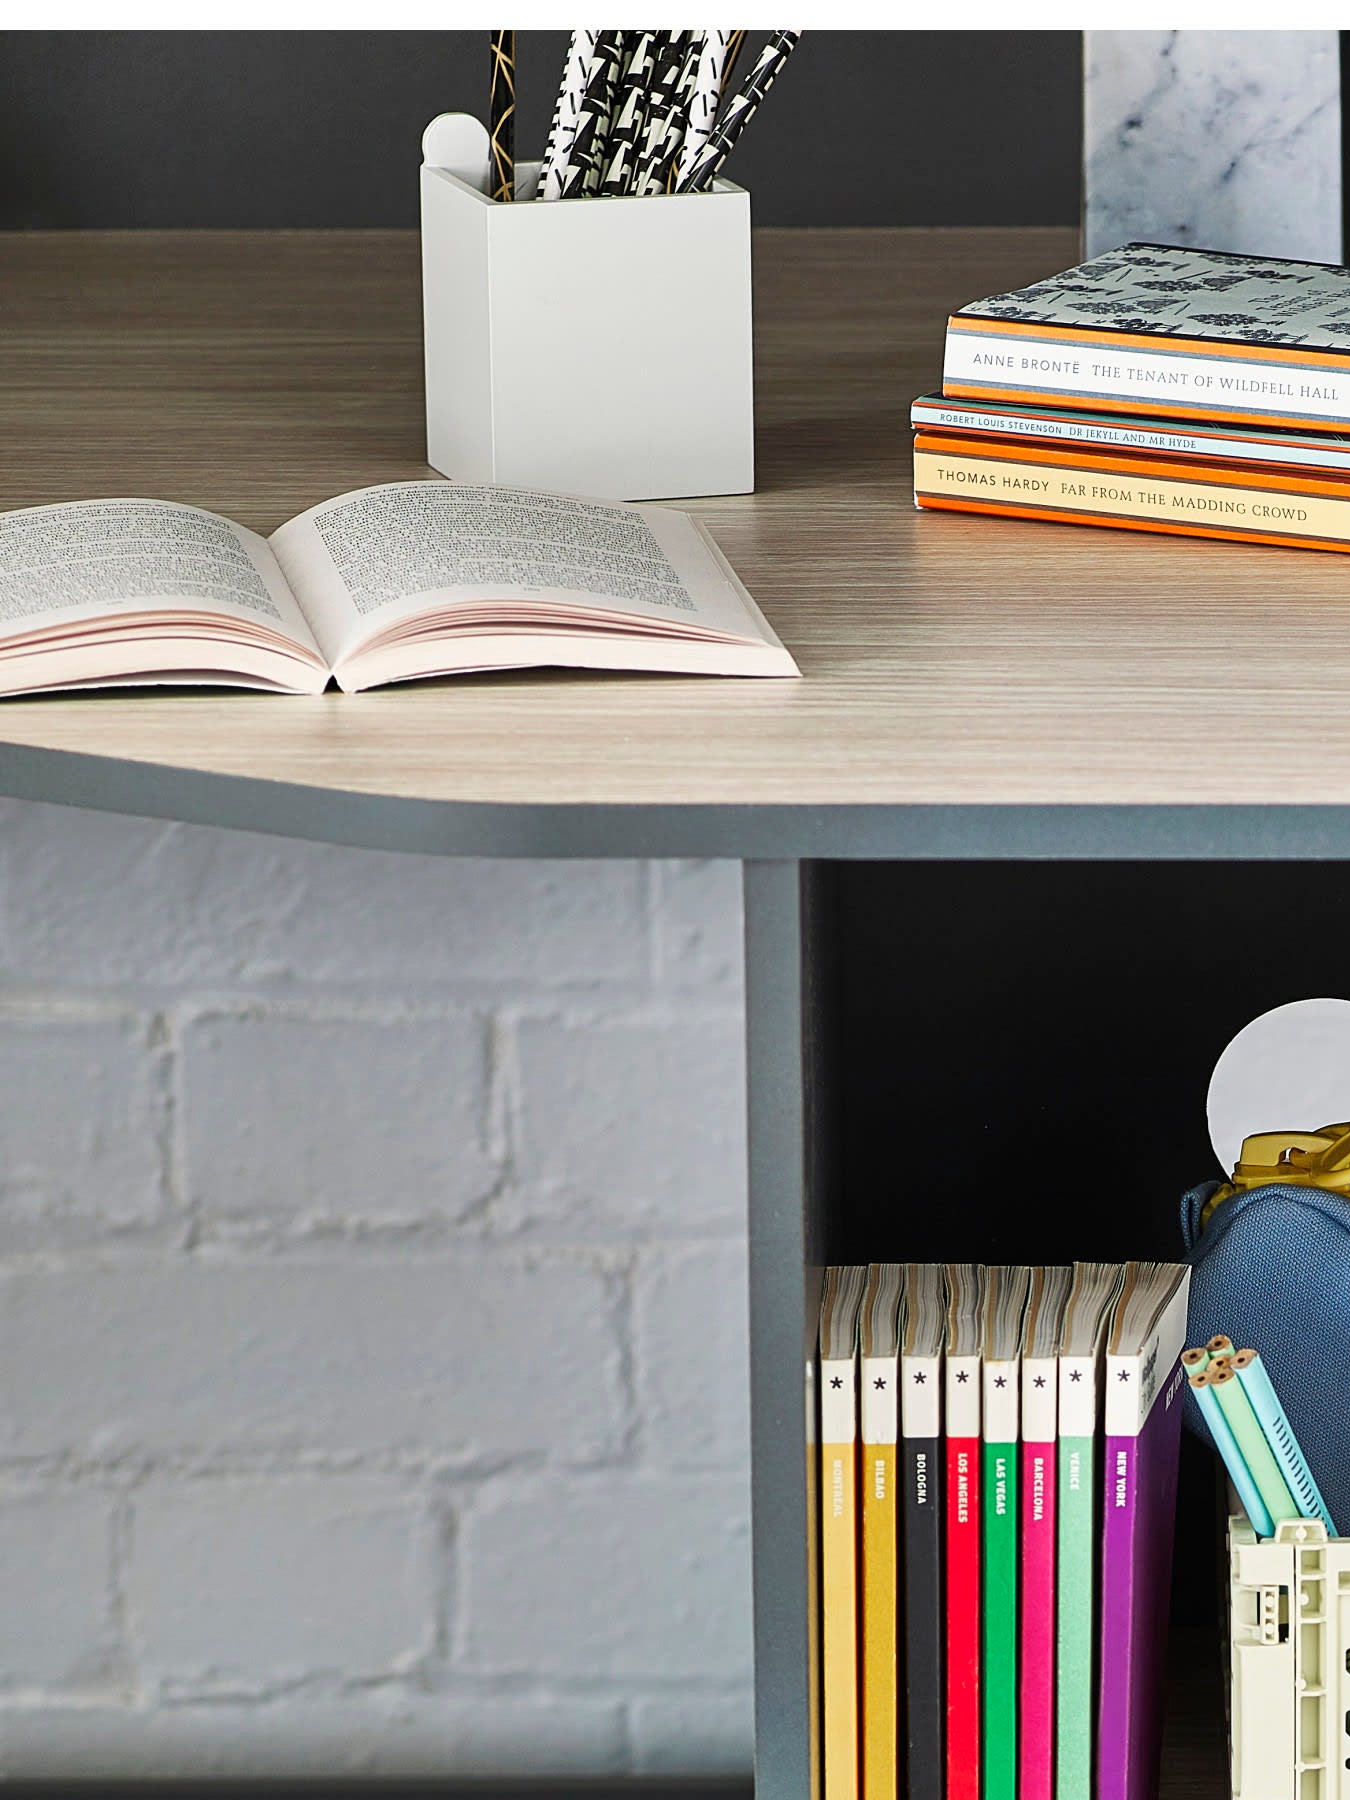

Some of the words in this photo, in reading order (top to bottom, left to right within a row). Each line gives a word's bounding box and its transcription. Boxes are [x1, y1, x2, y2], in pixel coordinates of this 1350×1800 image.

[973, 353, 1015, 368] ANNE
[1021, 358, 1080, 374] BRONTË
[1092, 364, 1121, 379] THE
[1127, 368, 1189, 385] TENANT
[1194, 375, 1213, 388] OF
[1219, 377, 1294, 396] WILDFELL
[1300, 385, 1339, 401] HALL
[940, 413, 975, 425] ROBERT
[978, 417, 1005, 428] LOUIS
[1008, 421, 1062, 435] STEVENSON
[1069, 426, 1083, 437] DR
[1086, 428, 1120, 441] JEKYLL
[1122, 432, 1145, 443] AND
[1149, 436, 1166, 446] MR
[1169, 438, 1197, 449] HYDE
[937, 469, 996, 486] THOMAS
[1003, 476, 1049, 492] HARDY
[1061, 482, 1086, 496] FAR
[1092, 487, 1132, 502] FROM
[1138, 492, 1166, 505] THE
[1172, 496, 1246, 515] MADDING
[1252, 504, 1307, 521] CROWD
[875, 1460, 885, 1499] BILBAO
[917, 1453, 926, 1504] BOLOGNA
[958, 1453, 968, 1472] LOS
[996, 1458, 1006, 1478] LAS
[1070, 1452, 1080, 1490] VENICE
[1117, 1451, 1127, 1474] NEW
[958, 1475, 968, 1523] ANGELES
[996, 1479, 1006, 1515] VEGAS
[1034, 1458, 1044, 1520] BARCELONA
[1116, 1474, 1126, 1507] YORK
